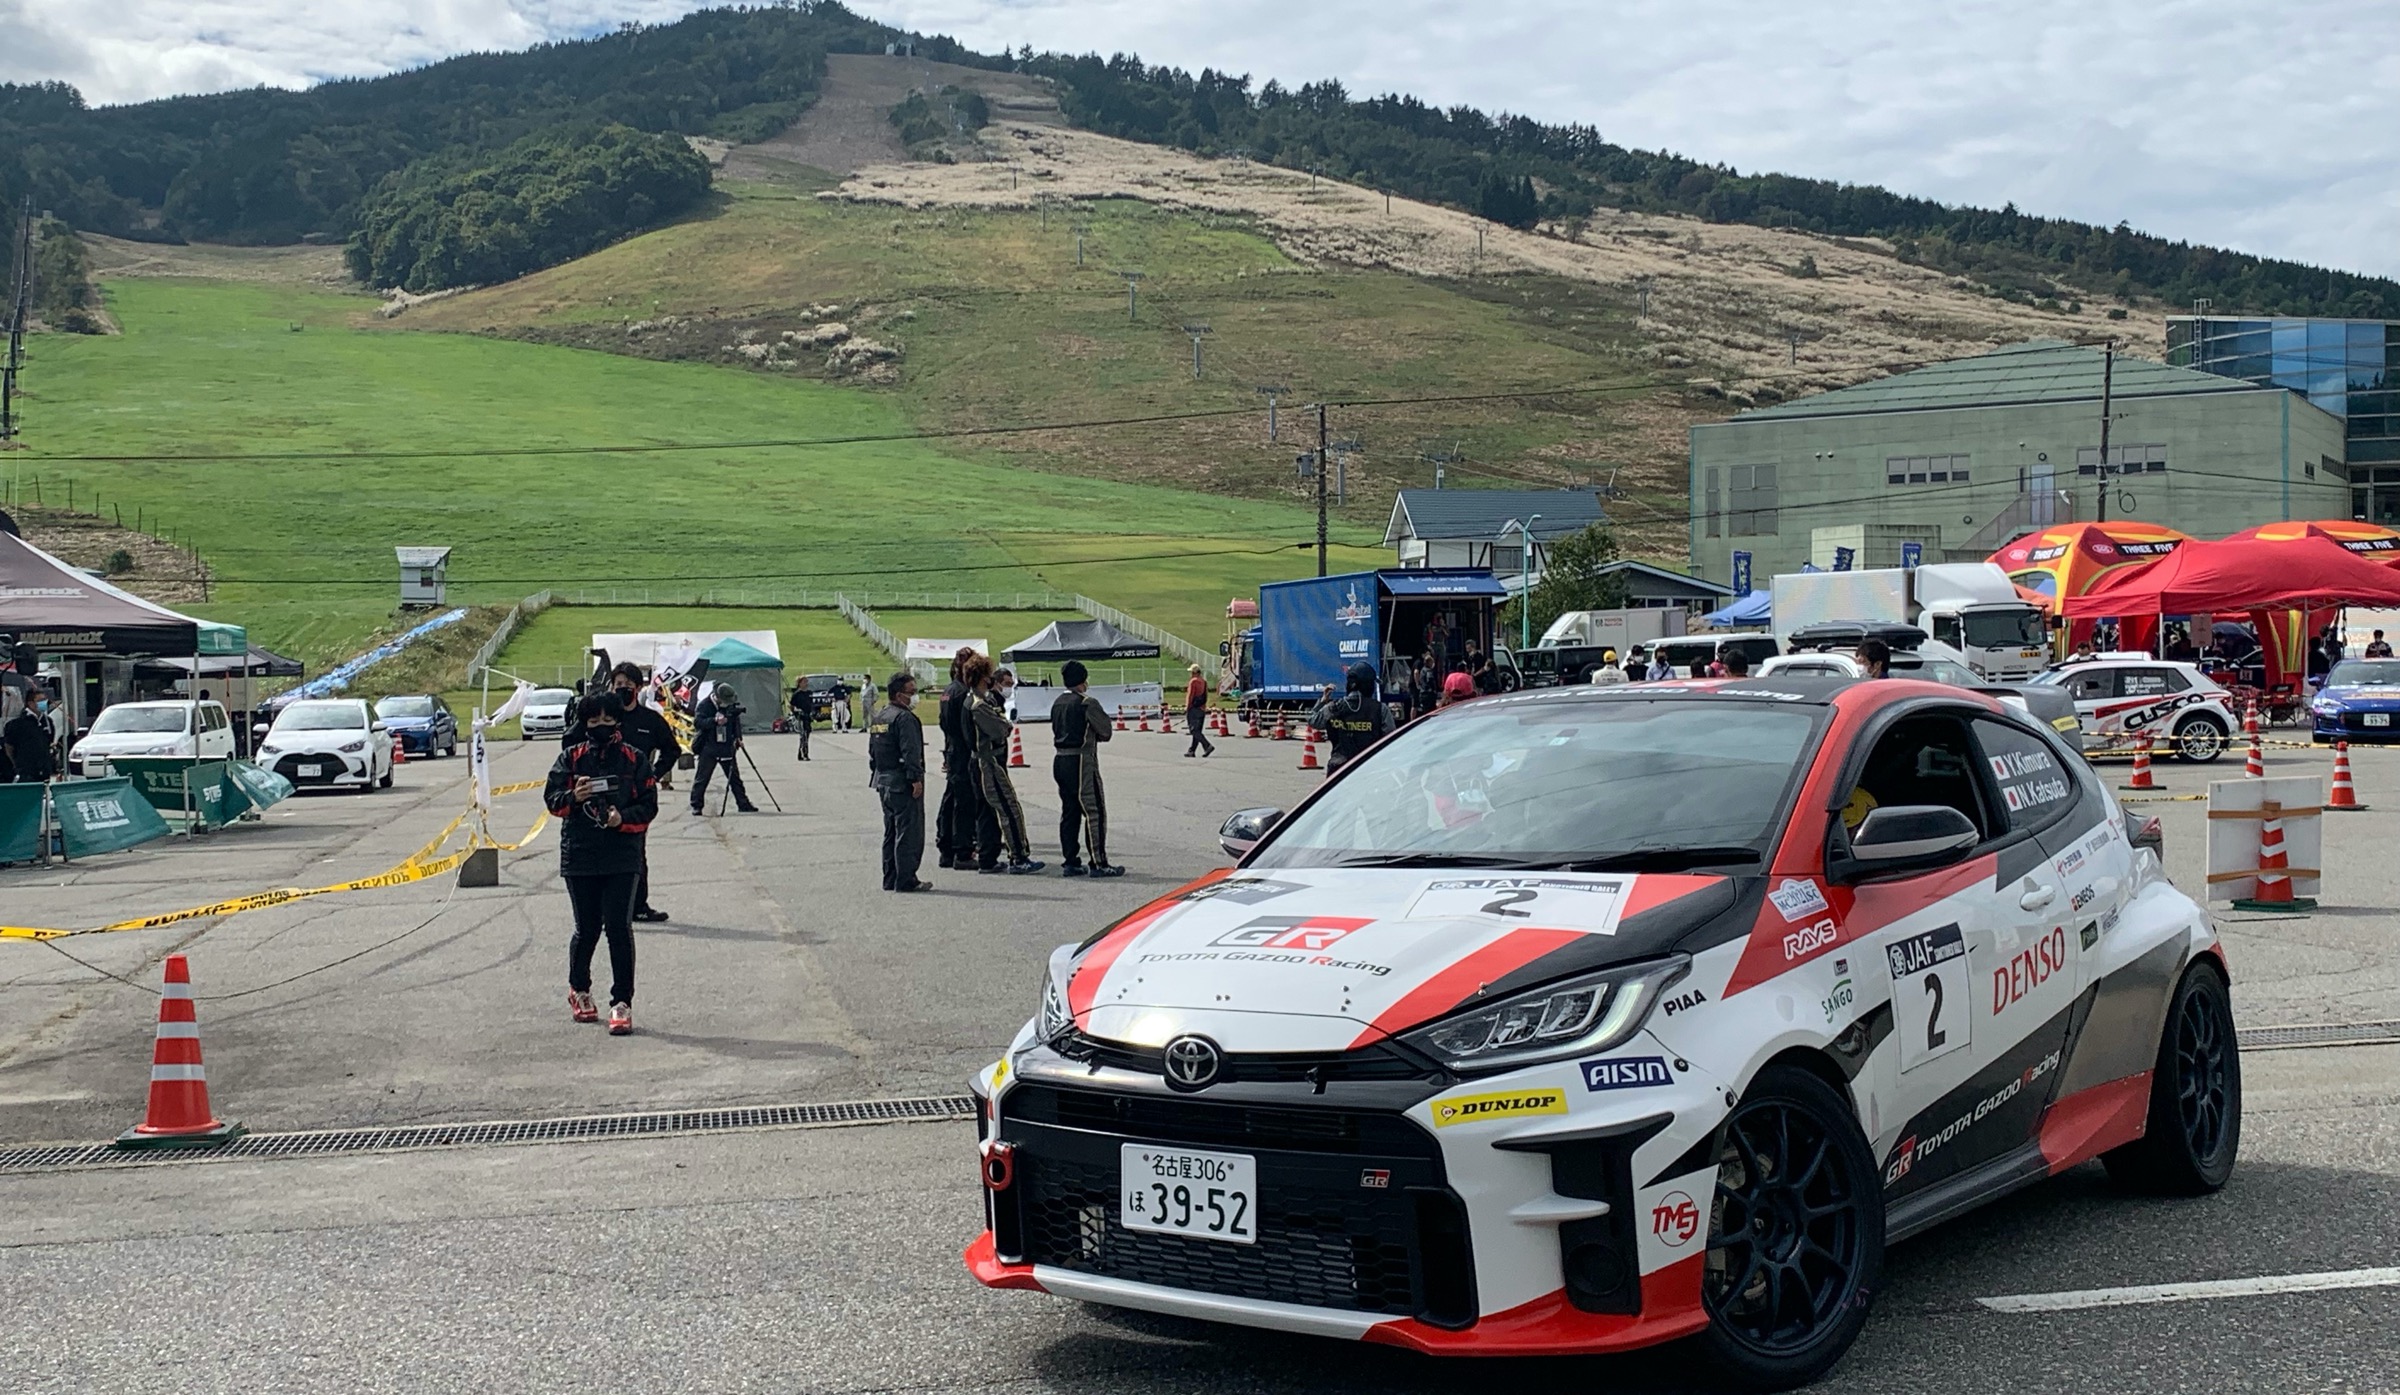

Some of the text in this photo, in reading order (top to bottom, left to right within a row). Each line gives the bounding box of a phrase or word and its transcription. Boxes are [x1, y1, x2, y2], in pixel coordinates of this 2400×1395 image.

[2121, 544, 2153, 554] THREE
[1339, 639, 1368, 652] CARRY ART
[2124, 694, 2205, 730] CUSCO
[2003, 751, 2052, 776] Y.Kimura
[2016, 777, 2068, 809] N.Katsuta
[1469, 879, 1542, 889] JAF
[2075, 884, 2095, 909] ENEOS
[1480, 889, 1538, 918] 2
[1216, 926, 1348, 949] GR
[1786, 922, 1834, 957] RAYS
[1138, 952, 1392, 977] TOYOTA GAZOO Racing
[1907, 936, 1934, 972] JAF
[1993, 926, 2066, 1016] DENSO
[1663, 989, 1707, 1017] PIAA
[1822, 988, 1853, 1015] SANGO
[1924, 972, 1946, 1051] 2
[1590, 1063, 1666, 1086] AISIN
[1461, 1096, 1556, 1115] DUNLOP
[1886, 1050, 2061, 1184] GR TOYOTA GAZOO Racing
[1362, 1175, 1388, 1186] GR
[1129, 1182, 1248, 1236] ほ 39-52
